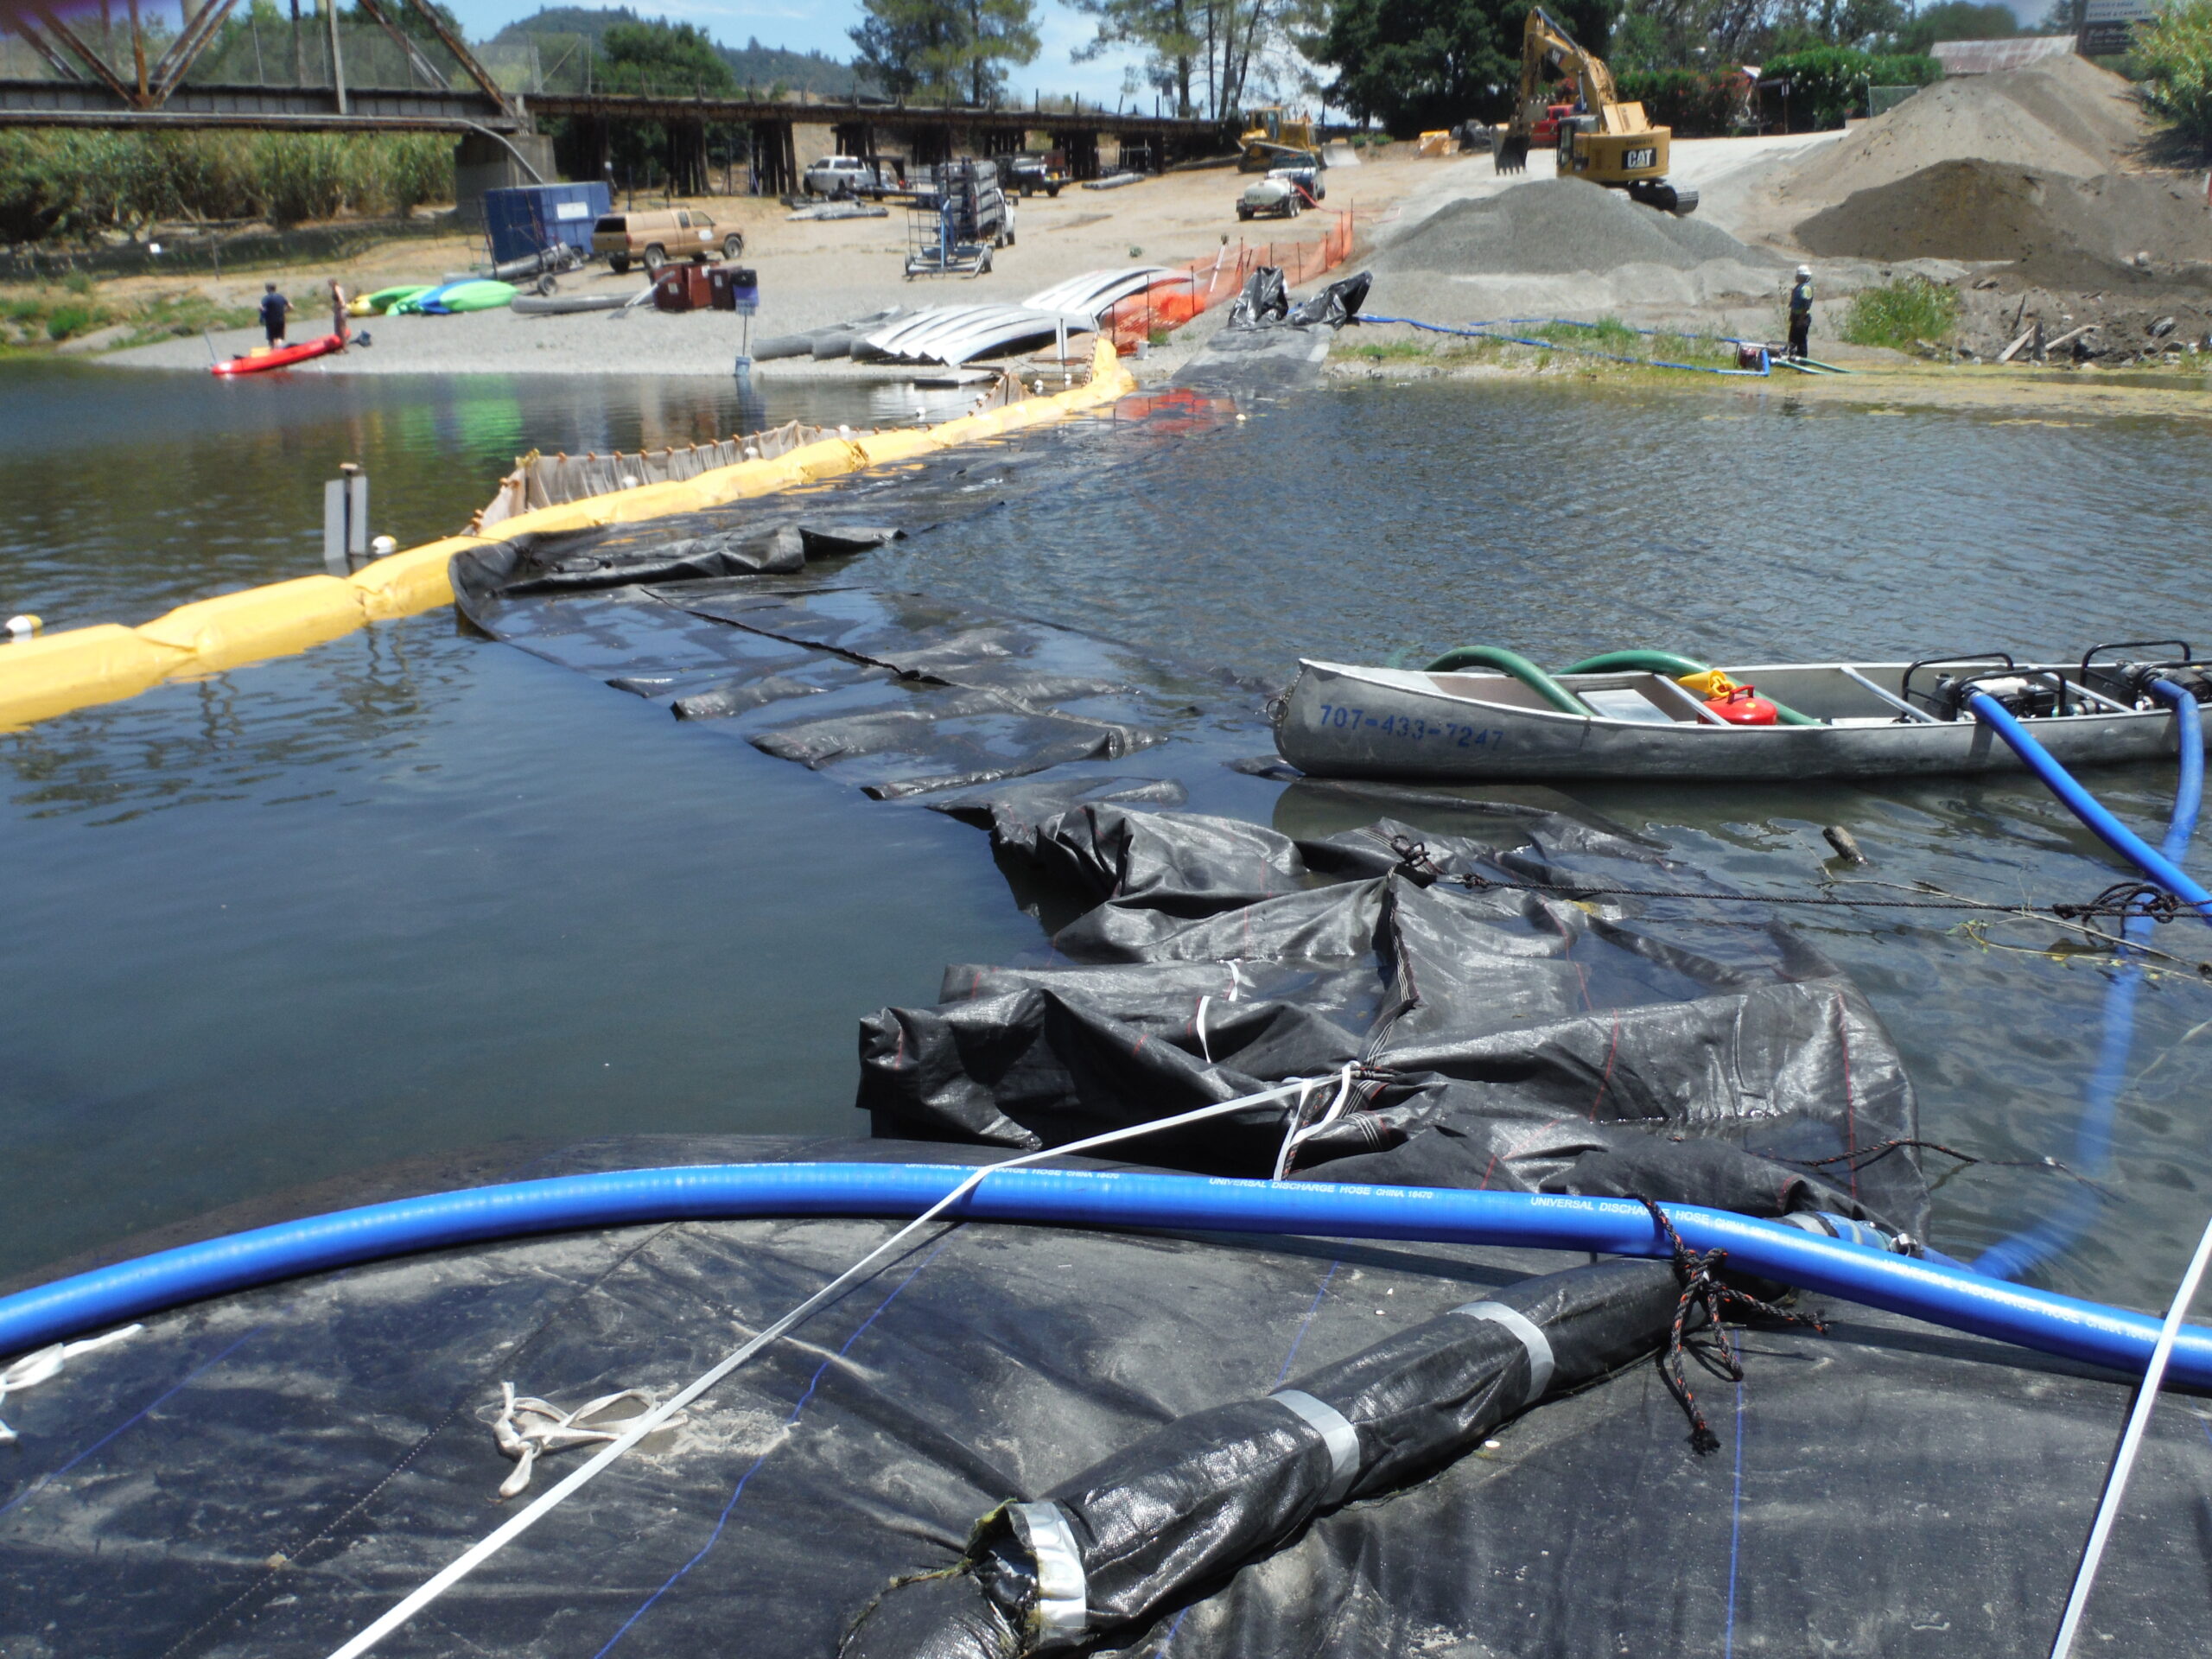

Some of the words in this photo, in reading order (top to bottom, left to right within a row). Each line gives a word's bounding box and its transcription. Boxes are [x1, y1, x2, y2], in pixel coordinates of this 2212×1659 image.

[1628, 149, 1653, 168] CAT
[1320, 704, 1504, 750] 707-433-7247
[1032, 1168, 1063, 1177] HOSE
[1209, 1178, 1267, 1188] UNIVERSAL
[1271, 1180, 1335, 1193] DISCHARGE
[1340, 1185, 1371, 1196] HOSE
[1376, 1188, 1404, 1198] CHINA
[1530, 1196, 1594, 1211] UNIVERSAL
[1675, 1210, 1711, 1226] HOSE
